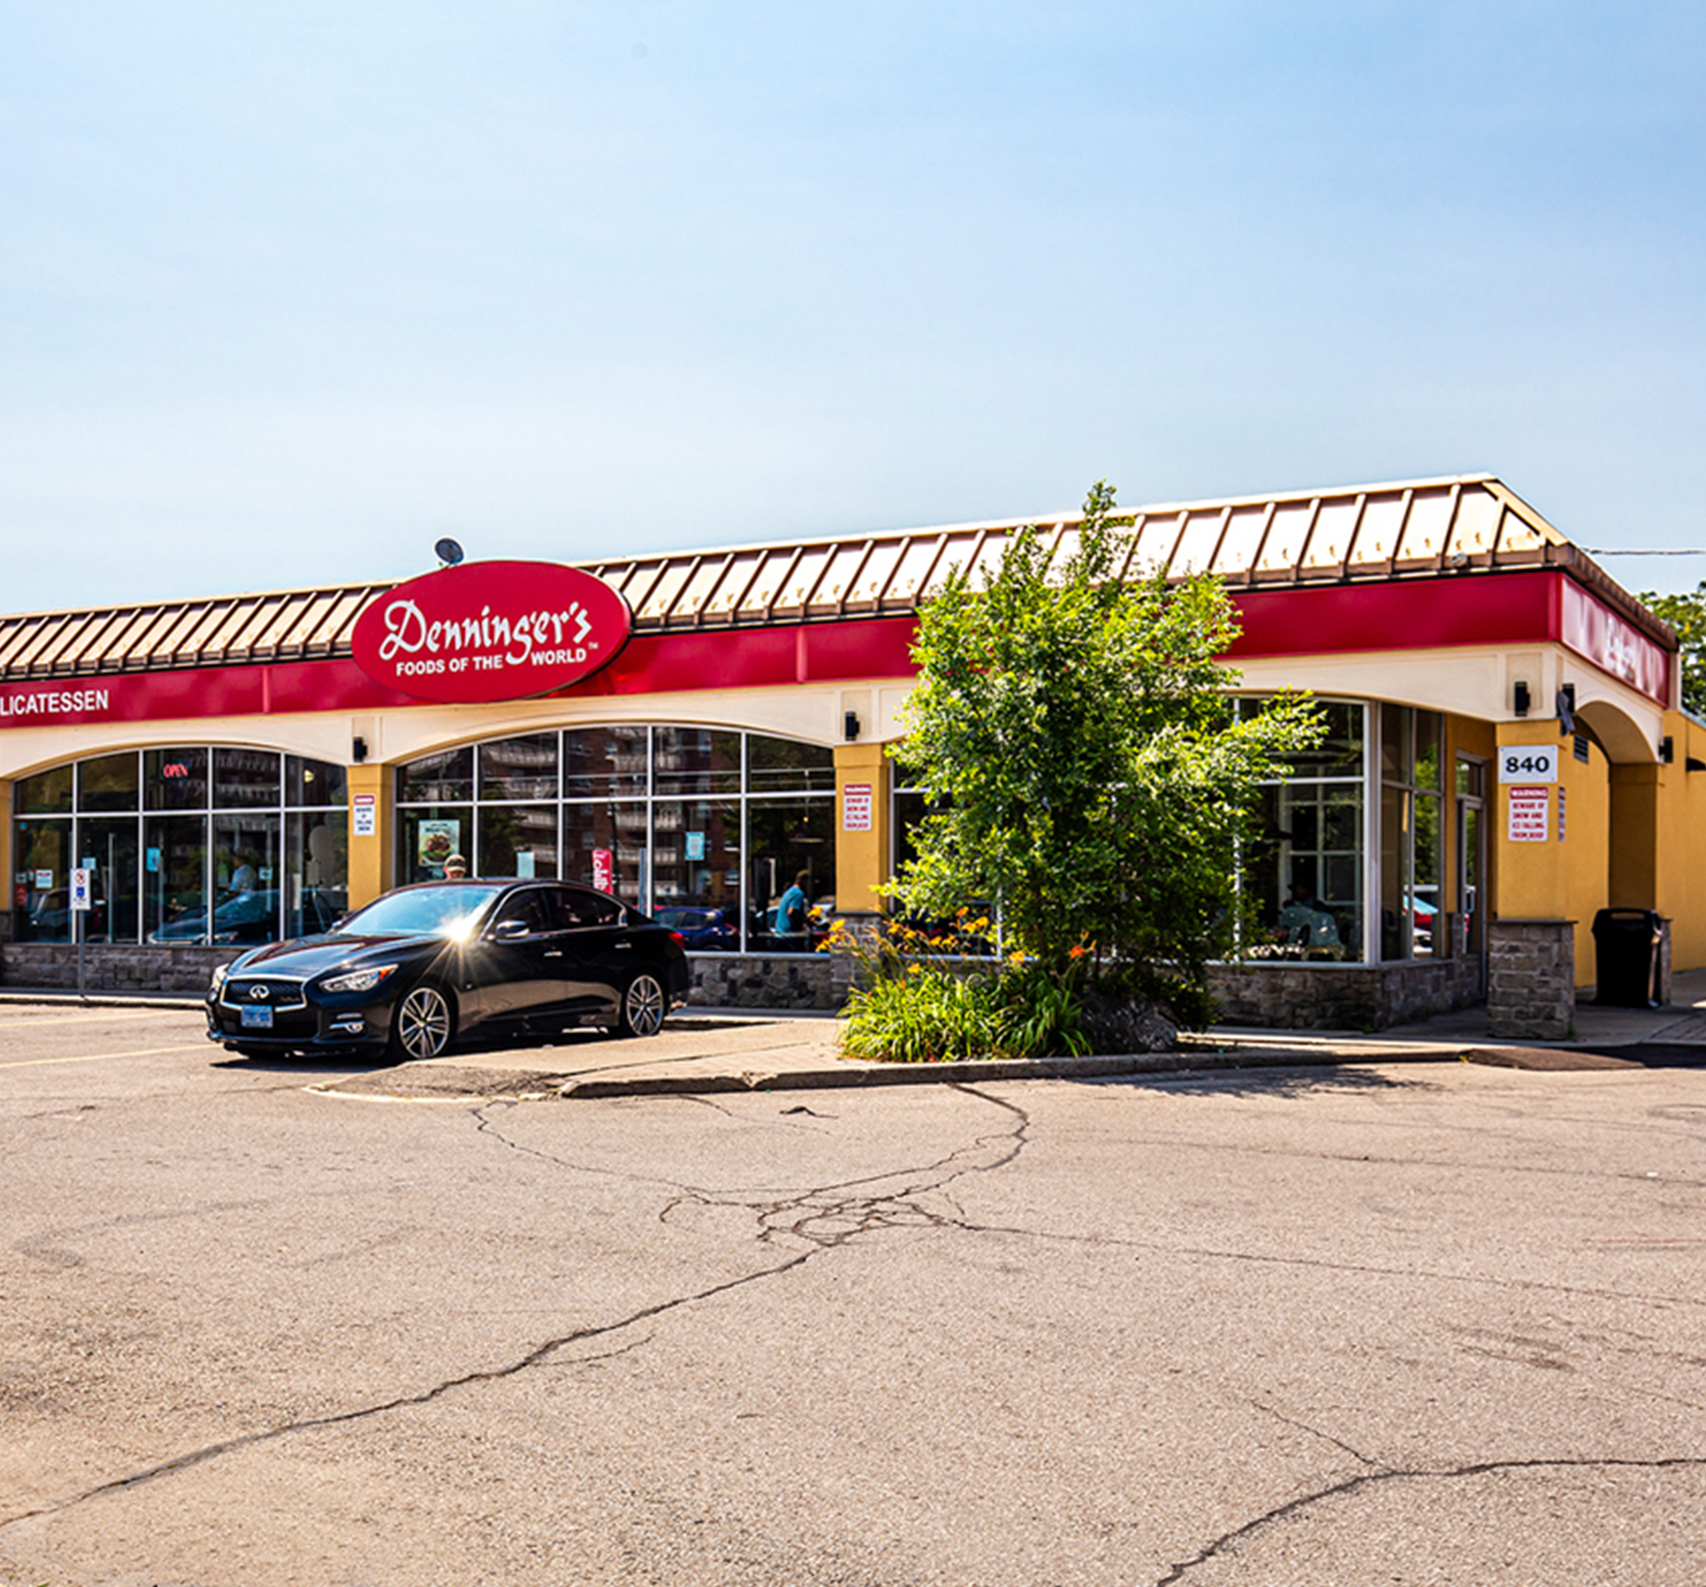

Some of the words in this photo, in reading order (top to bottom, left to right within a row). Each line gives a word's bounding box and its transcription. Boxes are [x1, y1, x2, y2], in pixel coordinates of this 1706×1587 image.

[379, 599, 592, 666] Denninger's
[396, 659, 445, 676] FOODS
[450, 657, 469, 672] OF
[473, 654, 503, 670] THE
[530, 649, 587, 666] WORLD
[0, 689, 108, 716] LICATESSEN
[1505, 756, 1550, 773] 840
